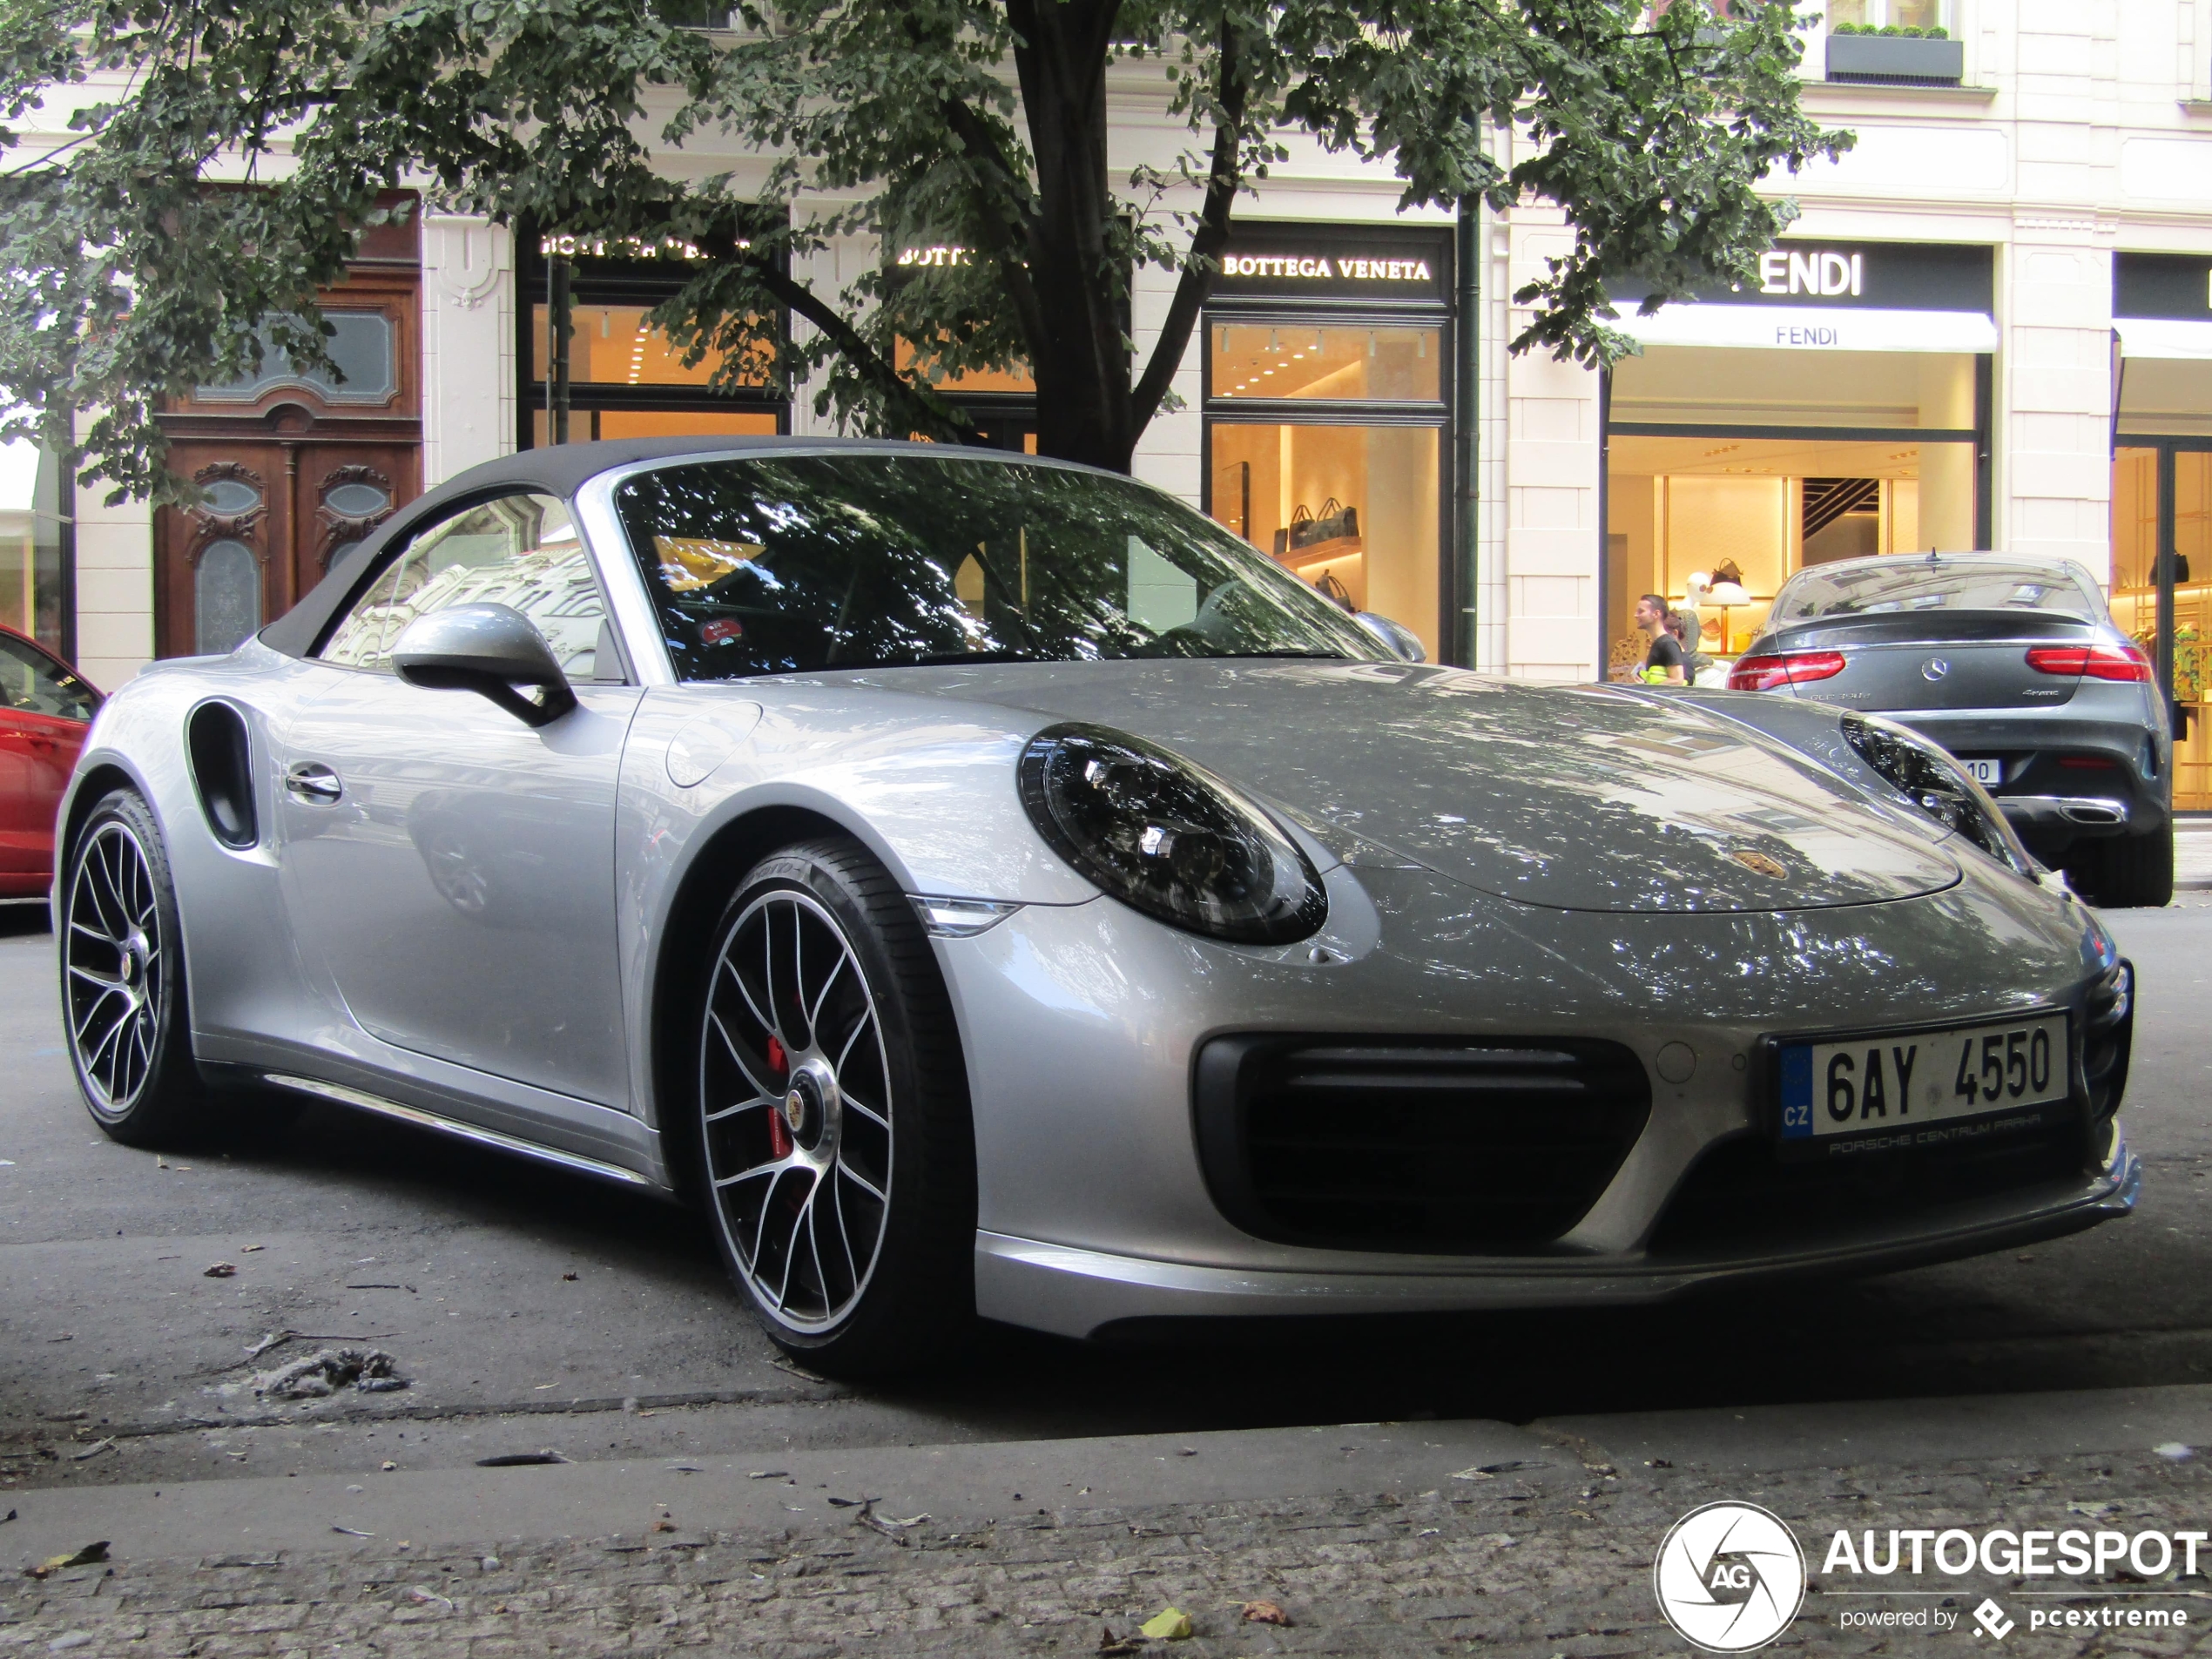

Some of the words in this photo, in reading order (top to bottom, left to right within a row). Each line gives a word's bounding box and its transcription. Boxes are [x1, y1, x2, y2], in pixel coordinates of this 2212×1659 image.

[1223, 257, 1332, 277] BOTTEGA
[1338, 260, 1431, 280] VENETA
[1731, 252, 1861, 296] ENDI
[1777, 327, 1838, 345] FENDI
[1827, 1045, 1917, 1123] 6AY
[1955, 1027, 2050, 1106] 4550
[1784, 1105, 1808, 1127] CZ
[1830, 1134, 1912, 1155] PORSCHE
[1917, 1123, 1991, 1143] CENTRUM
[1994, 1114, 2040, 1130] PRAHA
